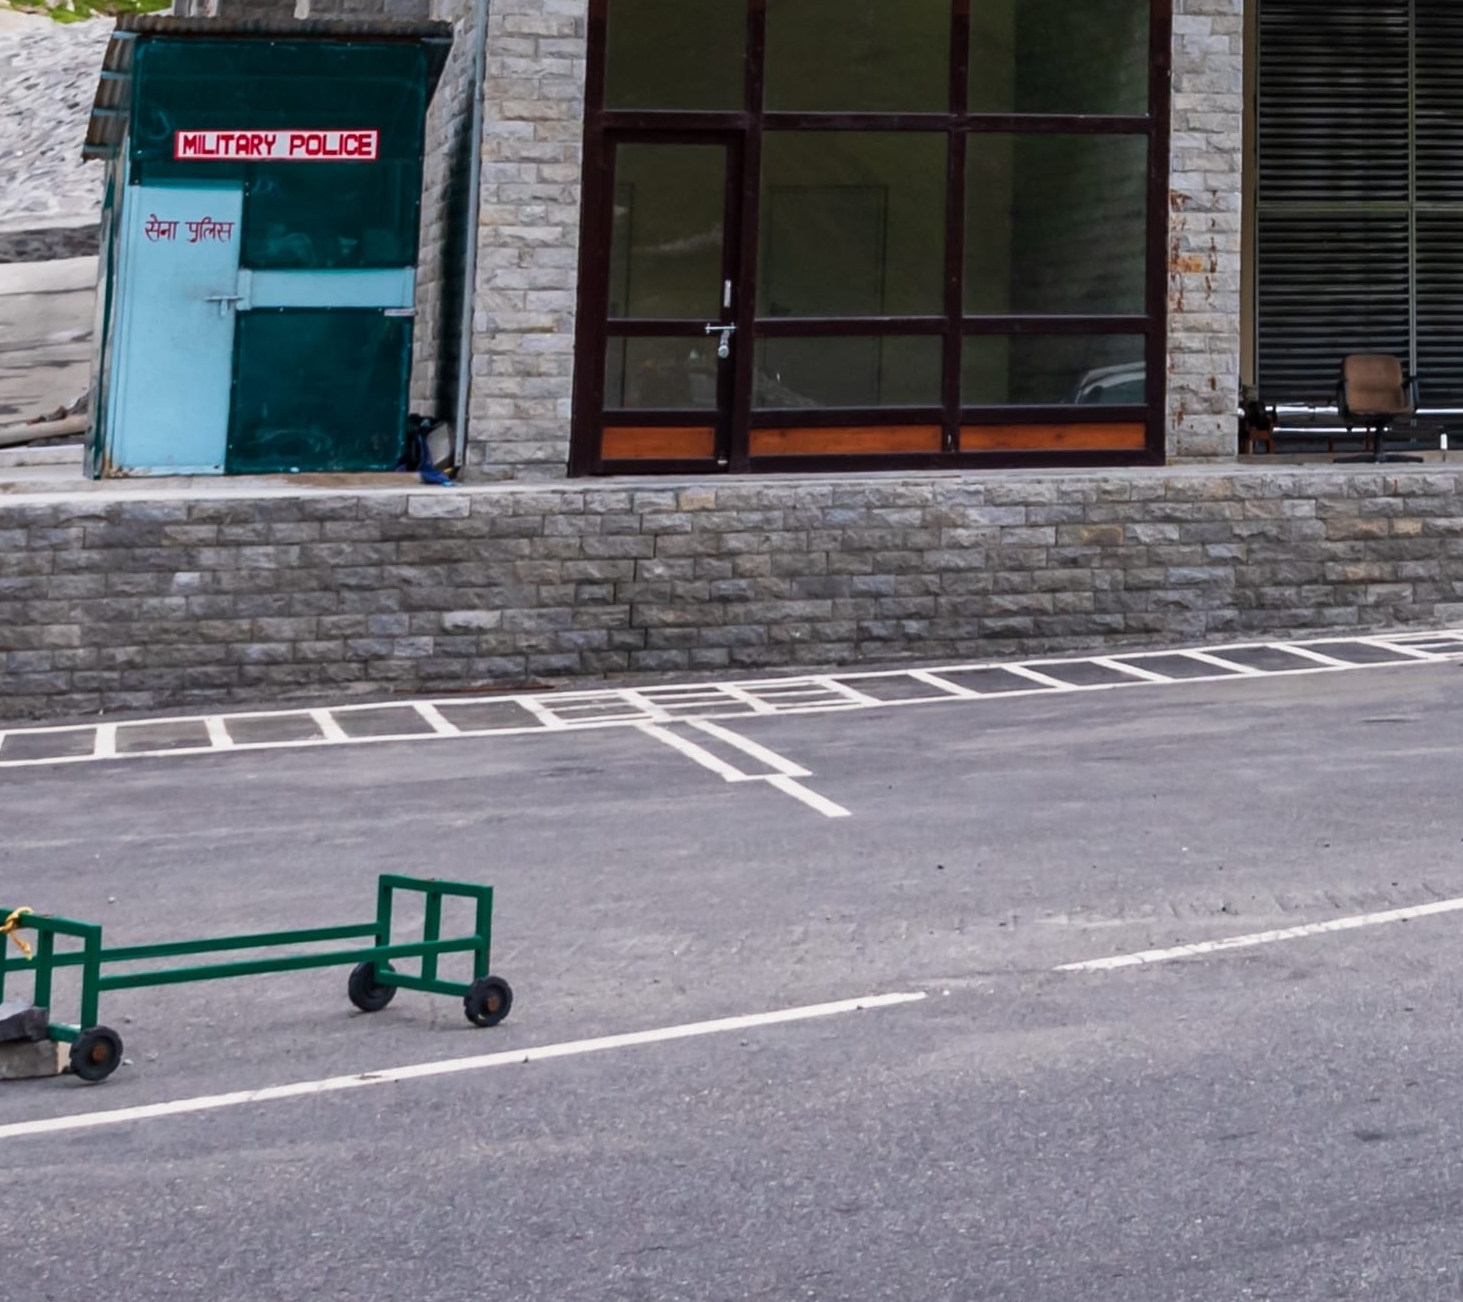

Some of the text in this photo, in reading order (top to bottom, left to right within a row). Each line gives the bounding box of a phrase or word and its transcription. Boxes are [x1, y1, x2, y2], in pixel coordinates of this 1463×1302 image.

[182, 133, 372, 156] MILITARY POLICE
[144, 213, 235, 243] सेना पुलिस
